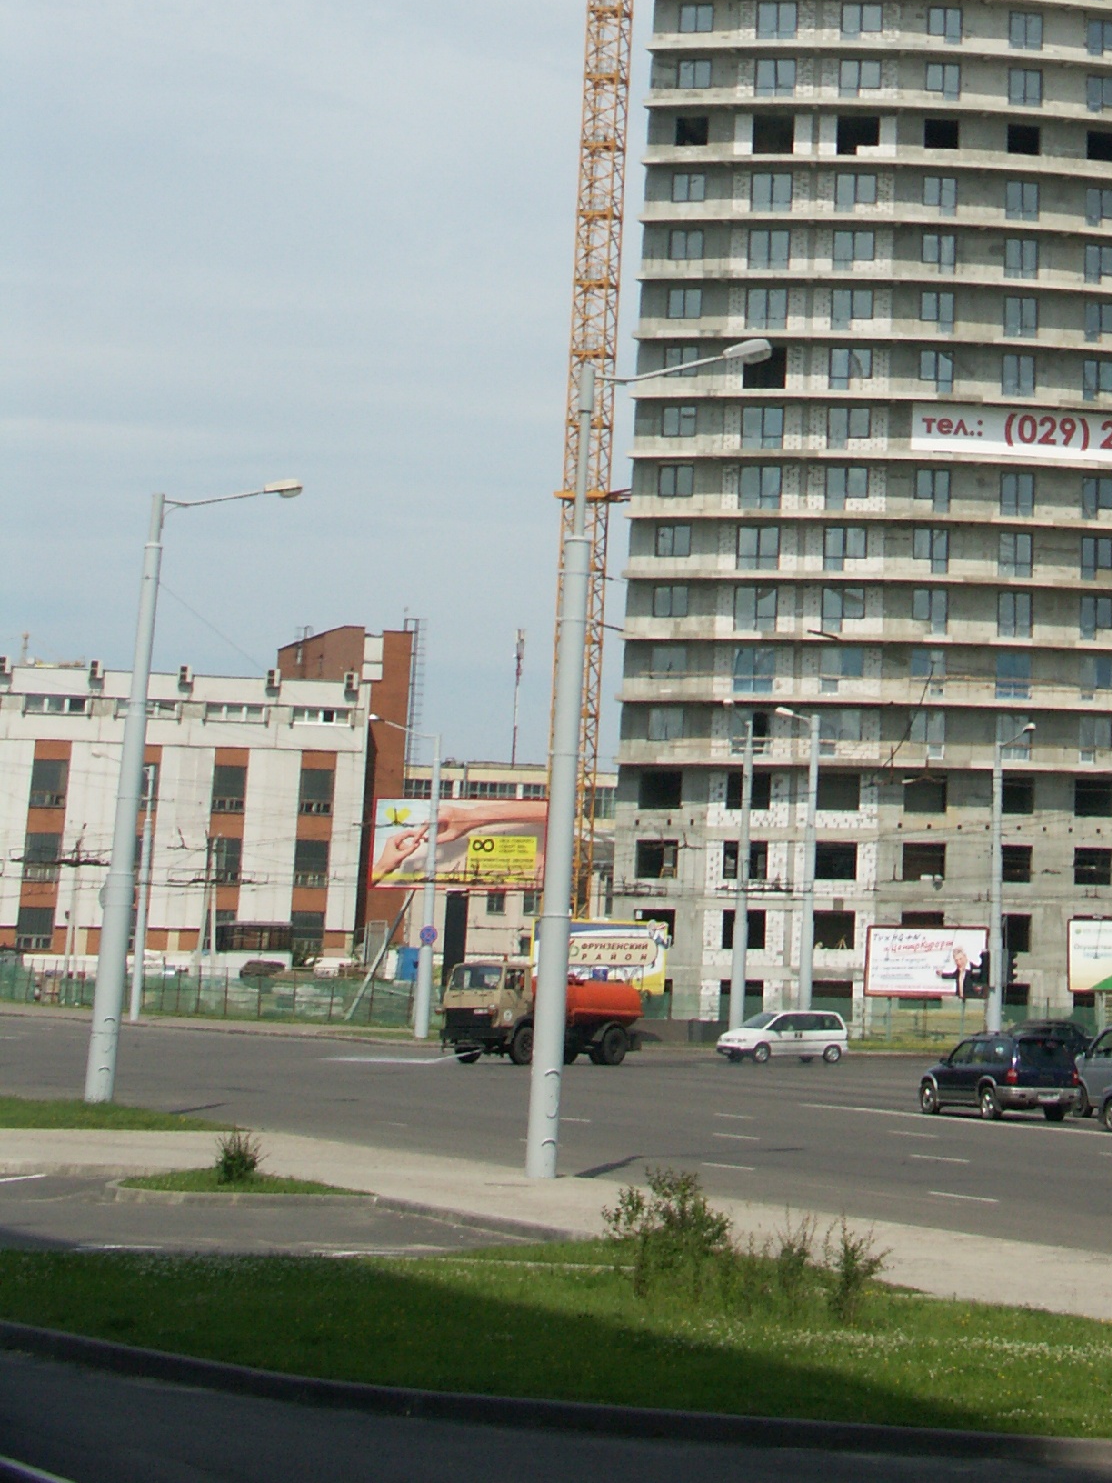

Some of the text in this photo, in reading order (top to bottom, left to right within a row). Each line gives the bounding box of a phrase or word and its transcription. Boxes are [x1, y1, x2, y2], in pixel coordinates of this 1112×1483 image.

[922, 417, 983, 437] тел.:
[1004, 412, 1090, 451] (029)
[581, 941, 648, 950] ФРУНЗЕНСКИЙ
